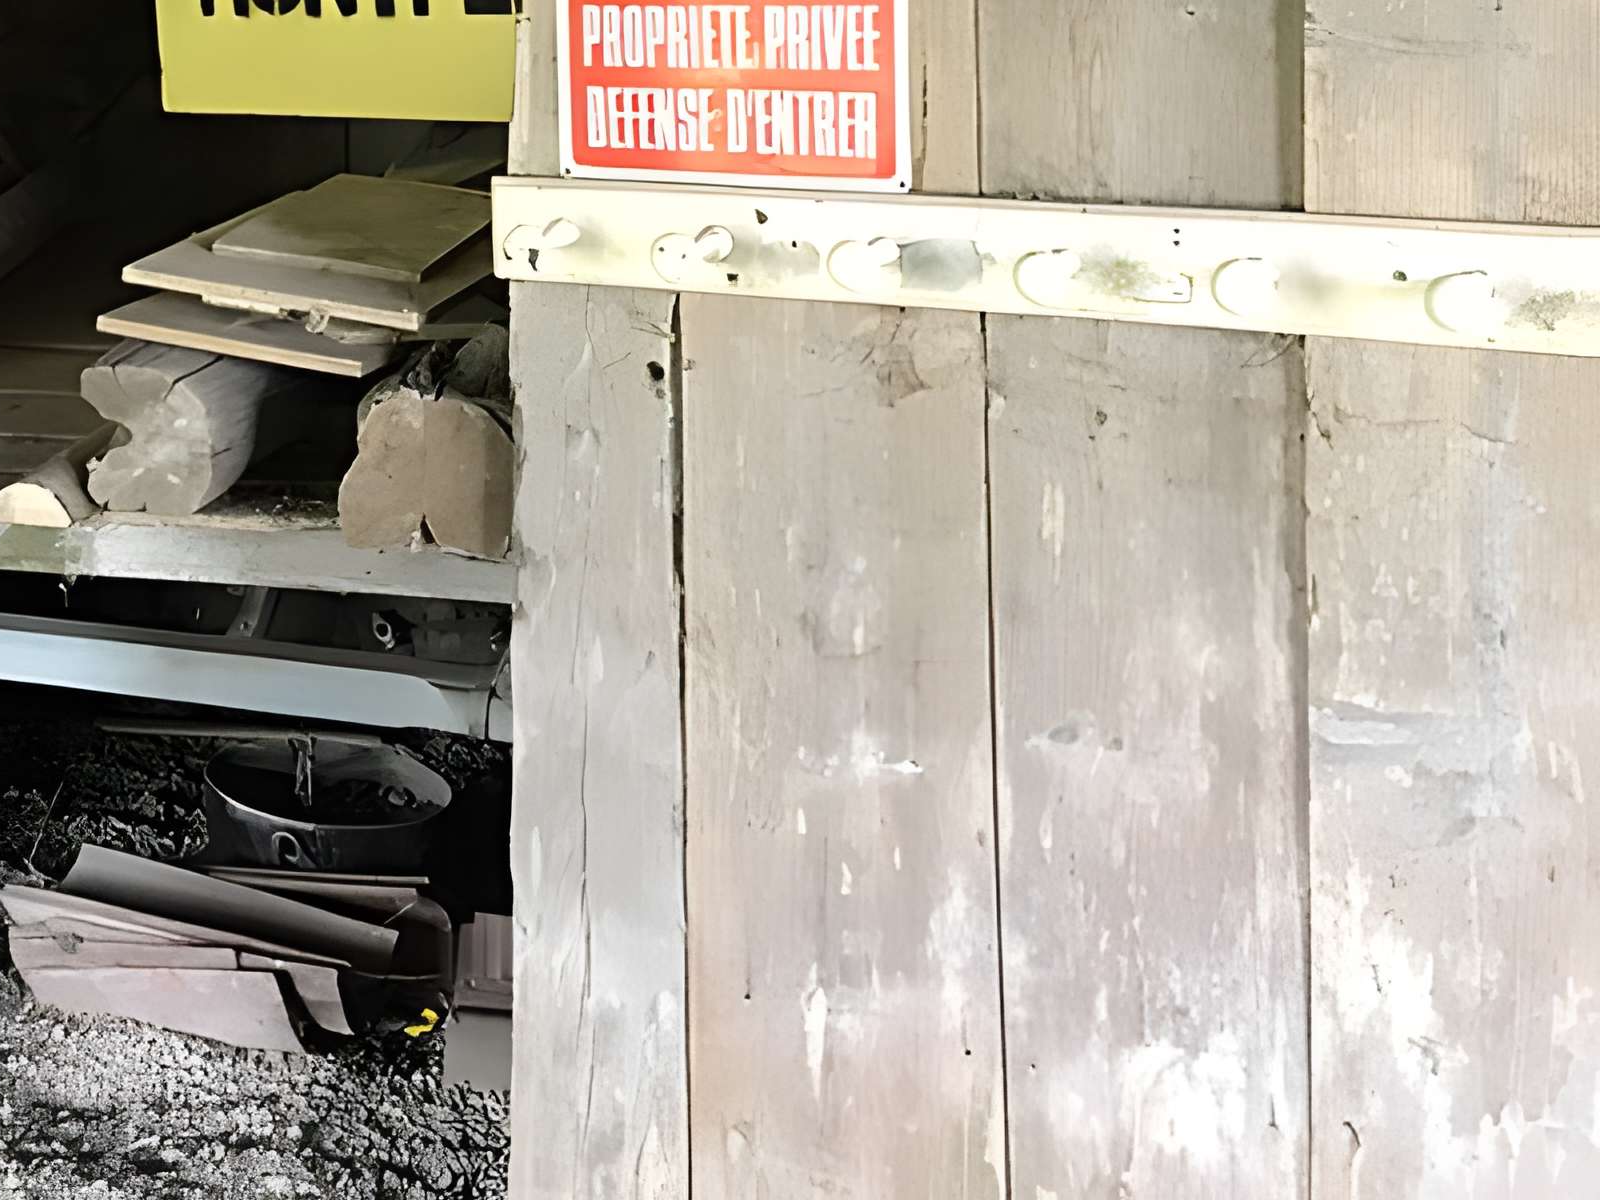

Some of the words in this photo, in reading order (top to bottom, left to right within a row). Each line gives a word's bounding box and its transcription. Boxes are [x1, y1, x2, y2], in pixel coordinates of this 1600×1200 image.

[582, 4, 753, 70] PROPRIETE
[764, 4, 880, 71] PRIVEE
[586, 85, 715, 152] DEFENSE
[726, 88, 877, 160] D'ENTRER
